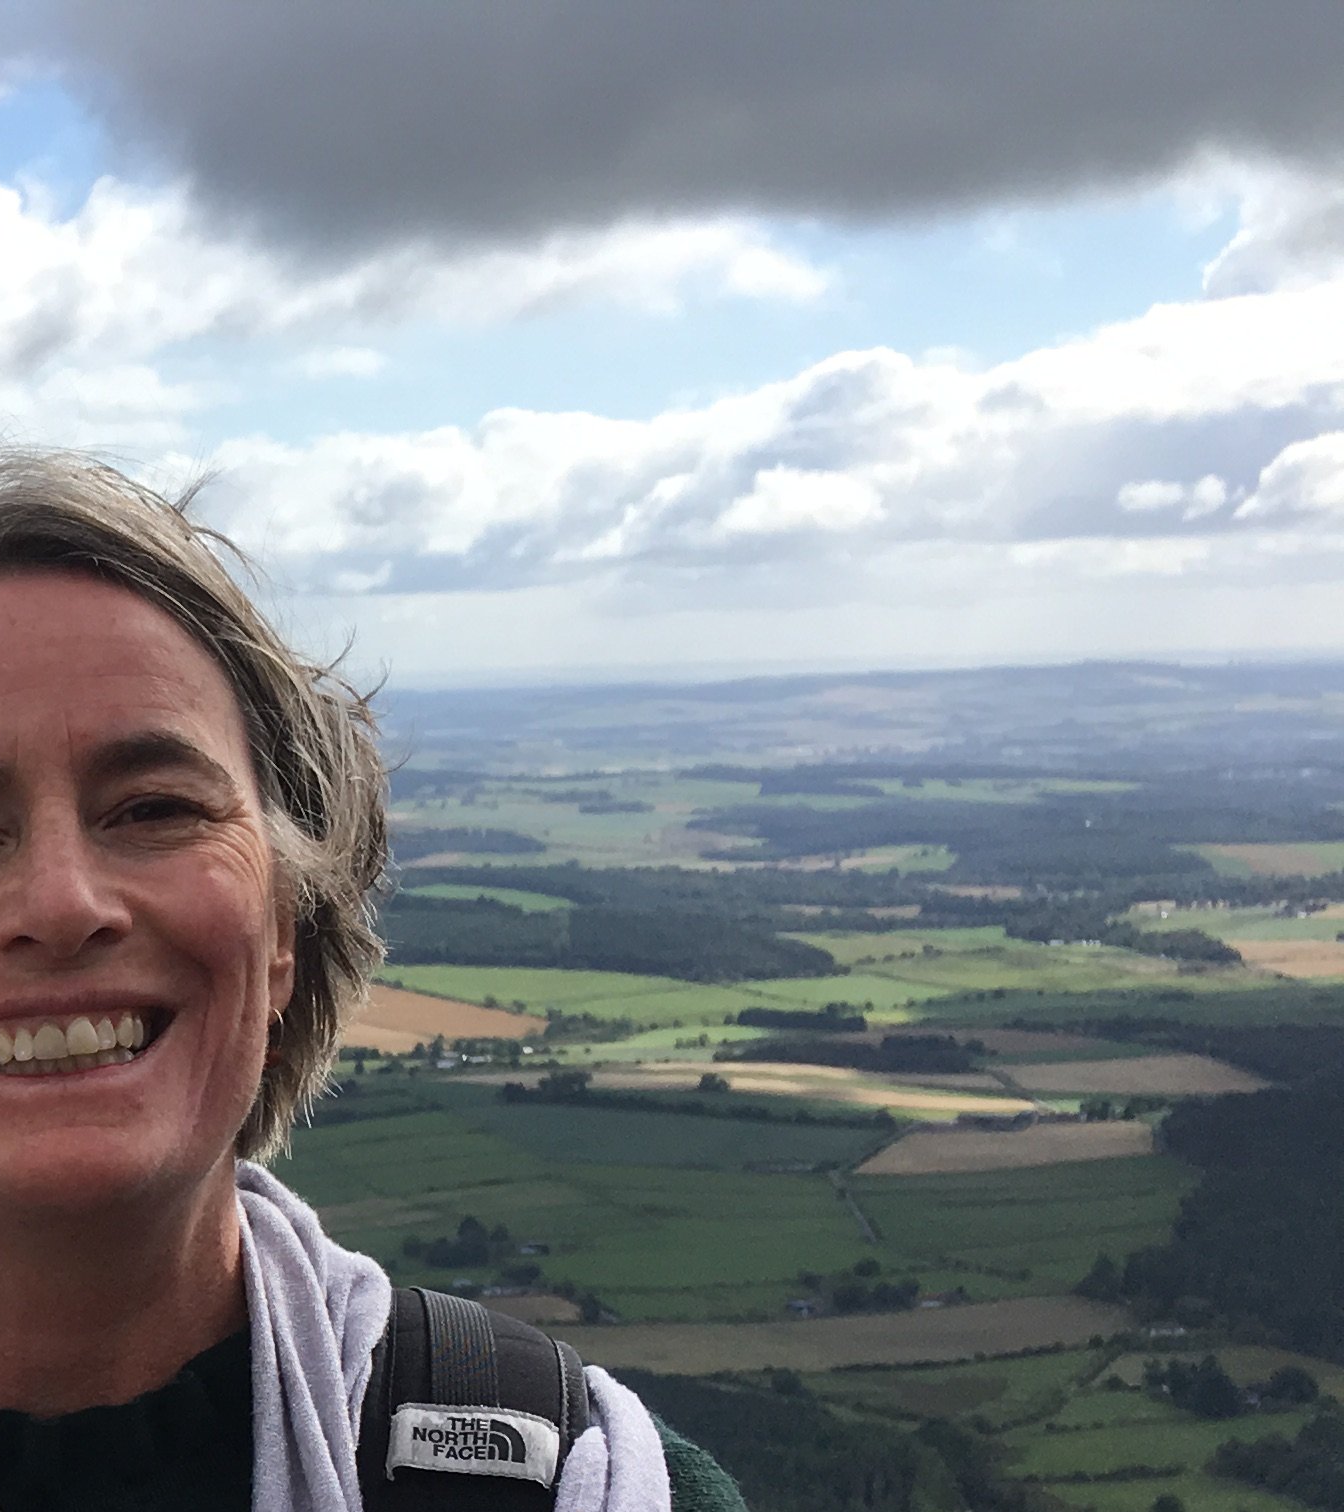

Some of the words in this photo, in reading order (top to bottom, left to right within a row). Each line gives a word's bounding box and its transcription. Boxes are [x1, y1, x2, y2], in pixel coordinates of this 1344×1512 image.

[447, 1417, 488, 1431] THE
[413, 1427, 487, 1445] NORTH
[433, 1444, 486, 1460] FACE
